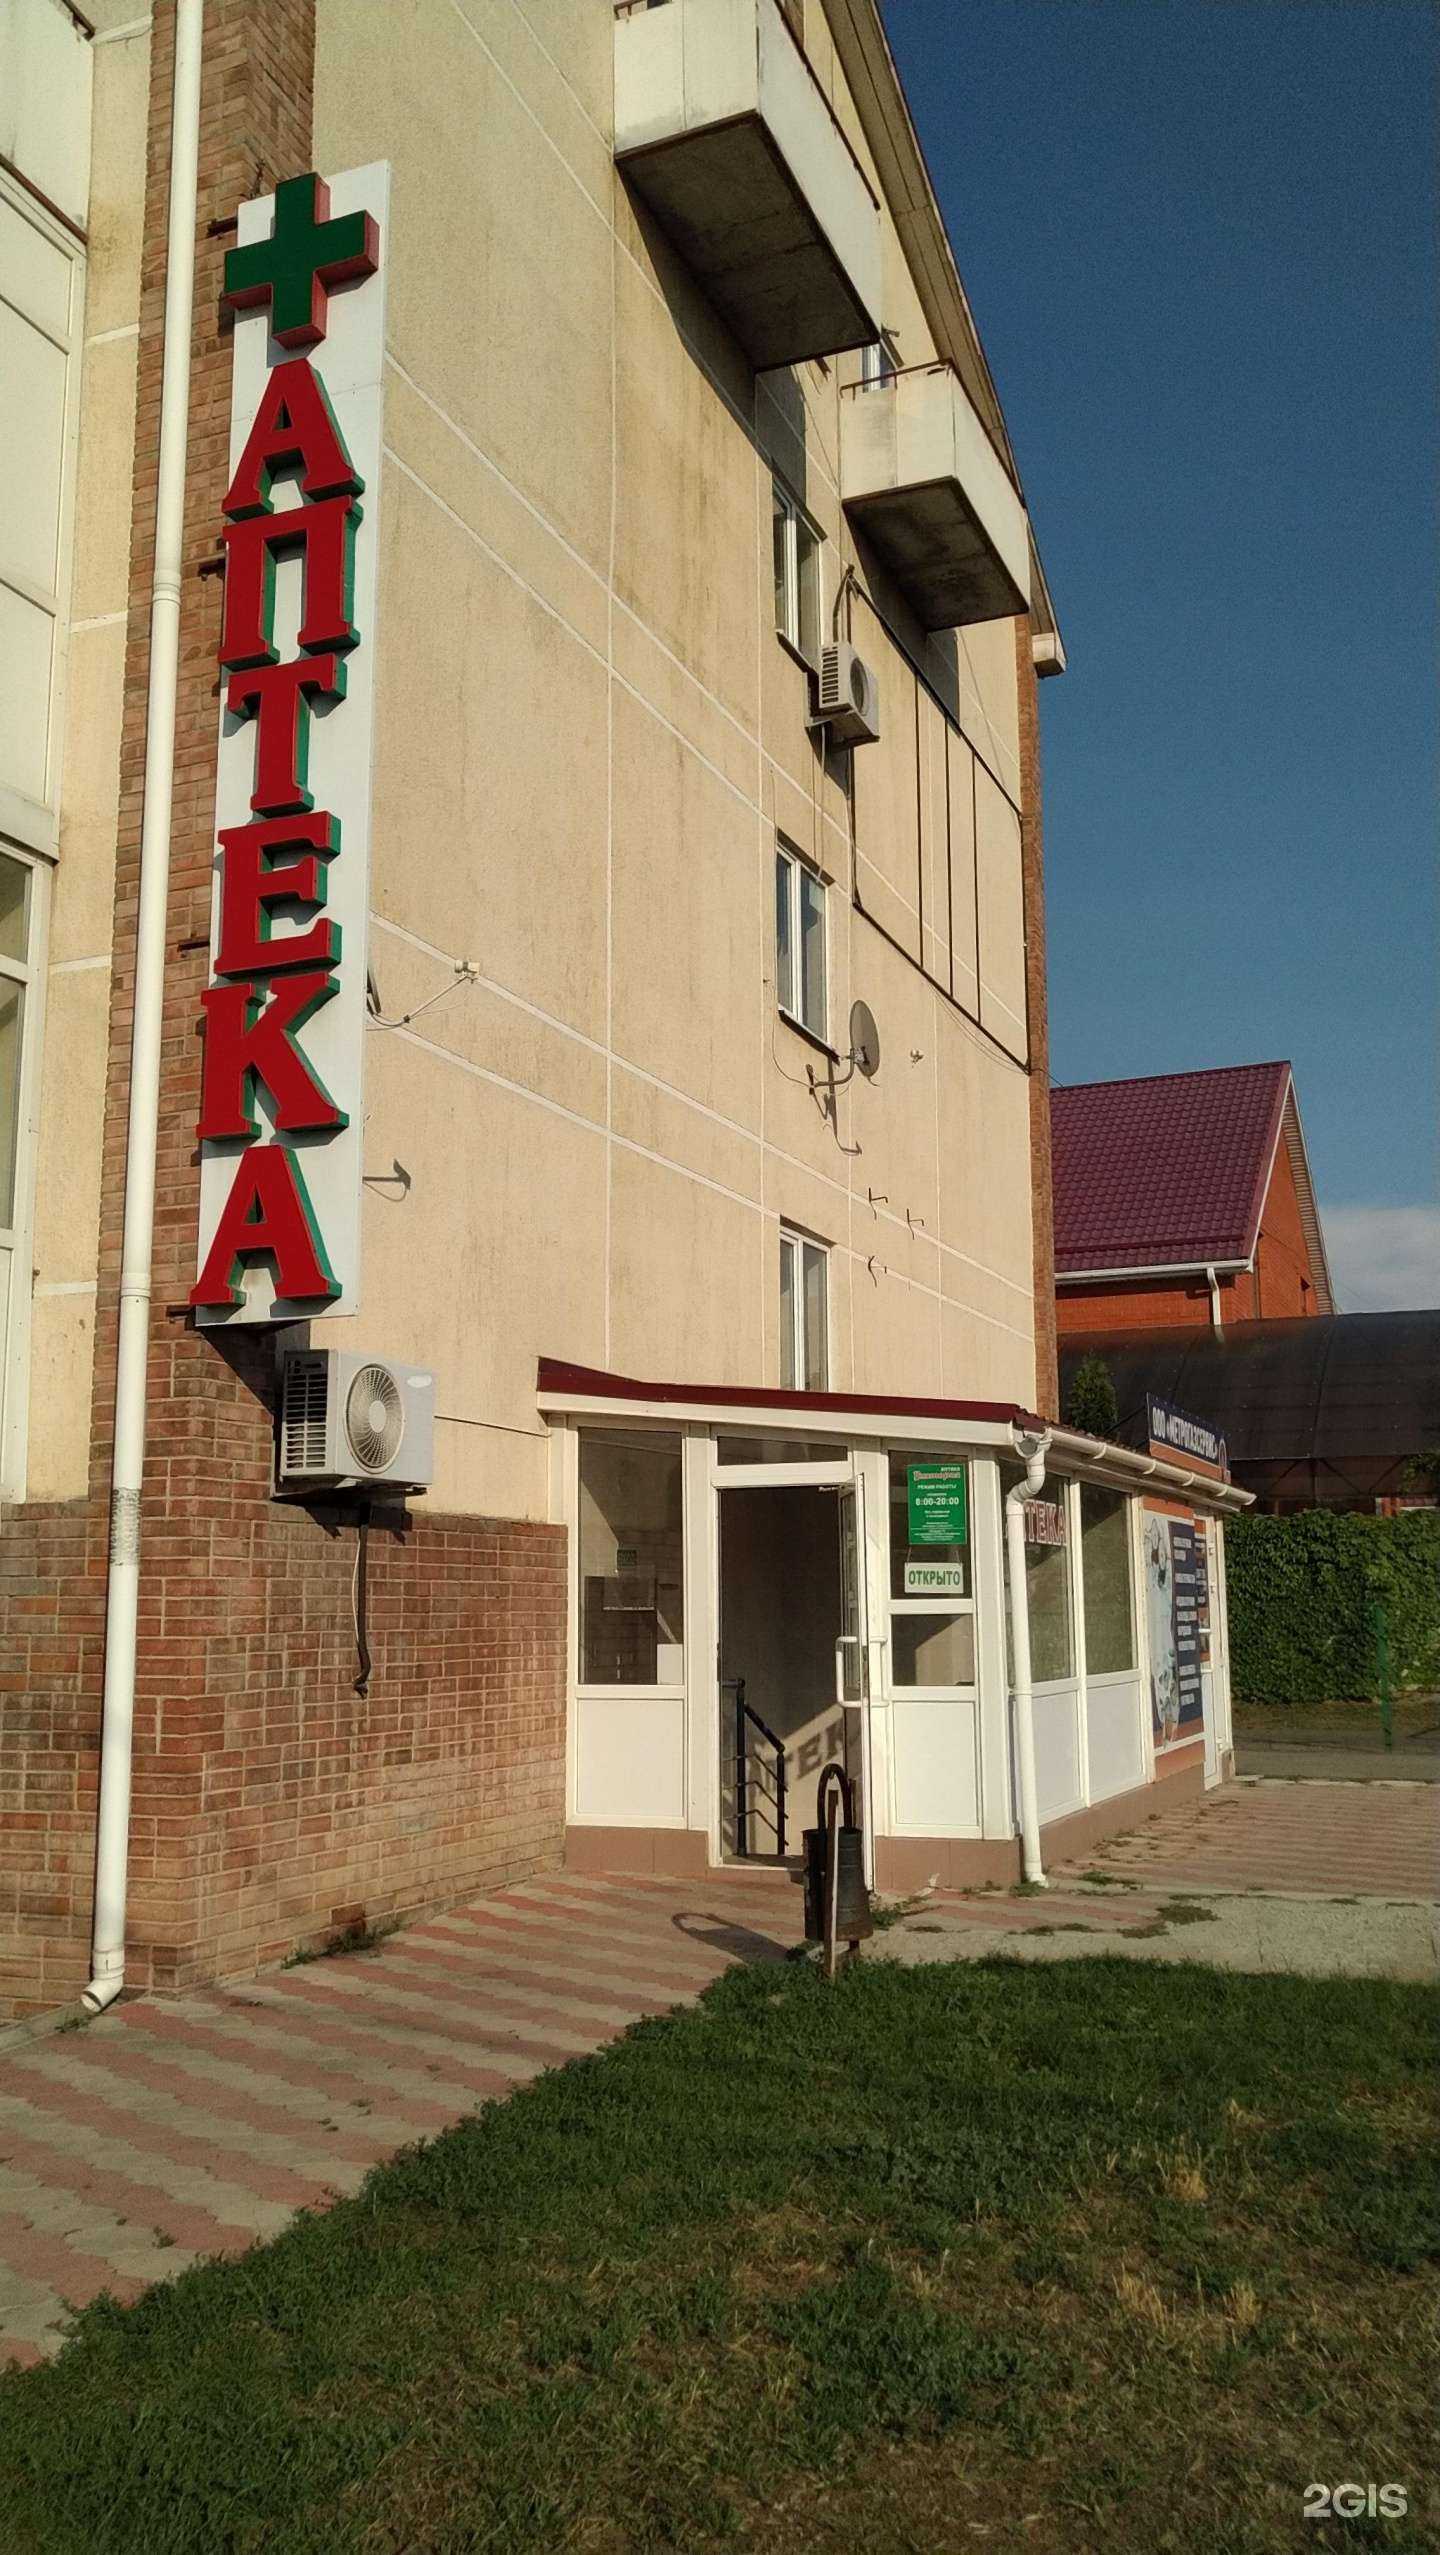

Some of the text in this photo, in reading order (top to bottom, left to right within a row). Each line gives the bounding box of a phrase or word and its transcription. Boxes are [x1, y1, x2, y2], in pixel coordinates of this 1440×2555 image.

[188, 357, 363, 1307] АПТЕКА
[1005, 1498, 1067, 1546] ТЕКА
[908, 1570, 961, 1586] ОТКРЫТО
